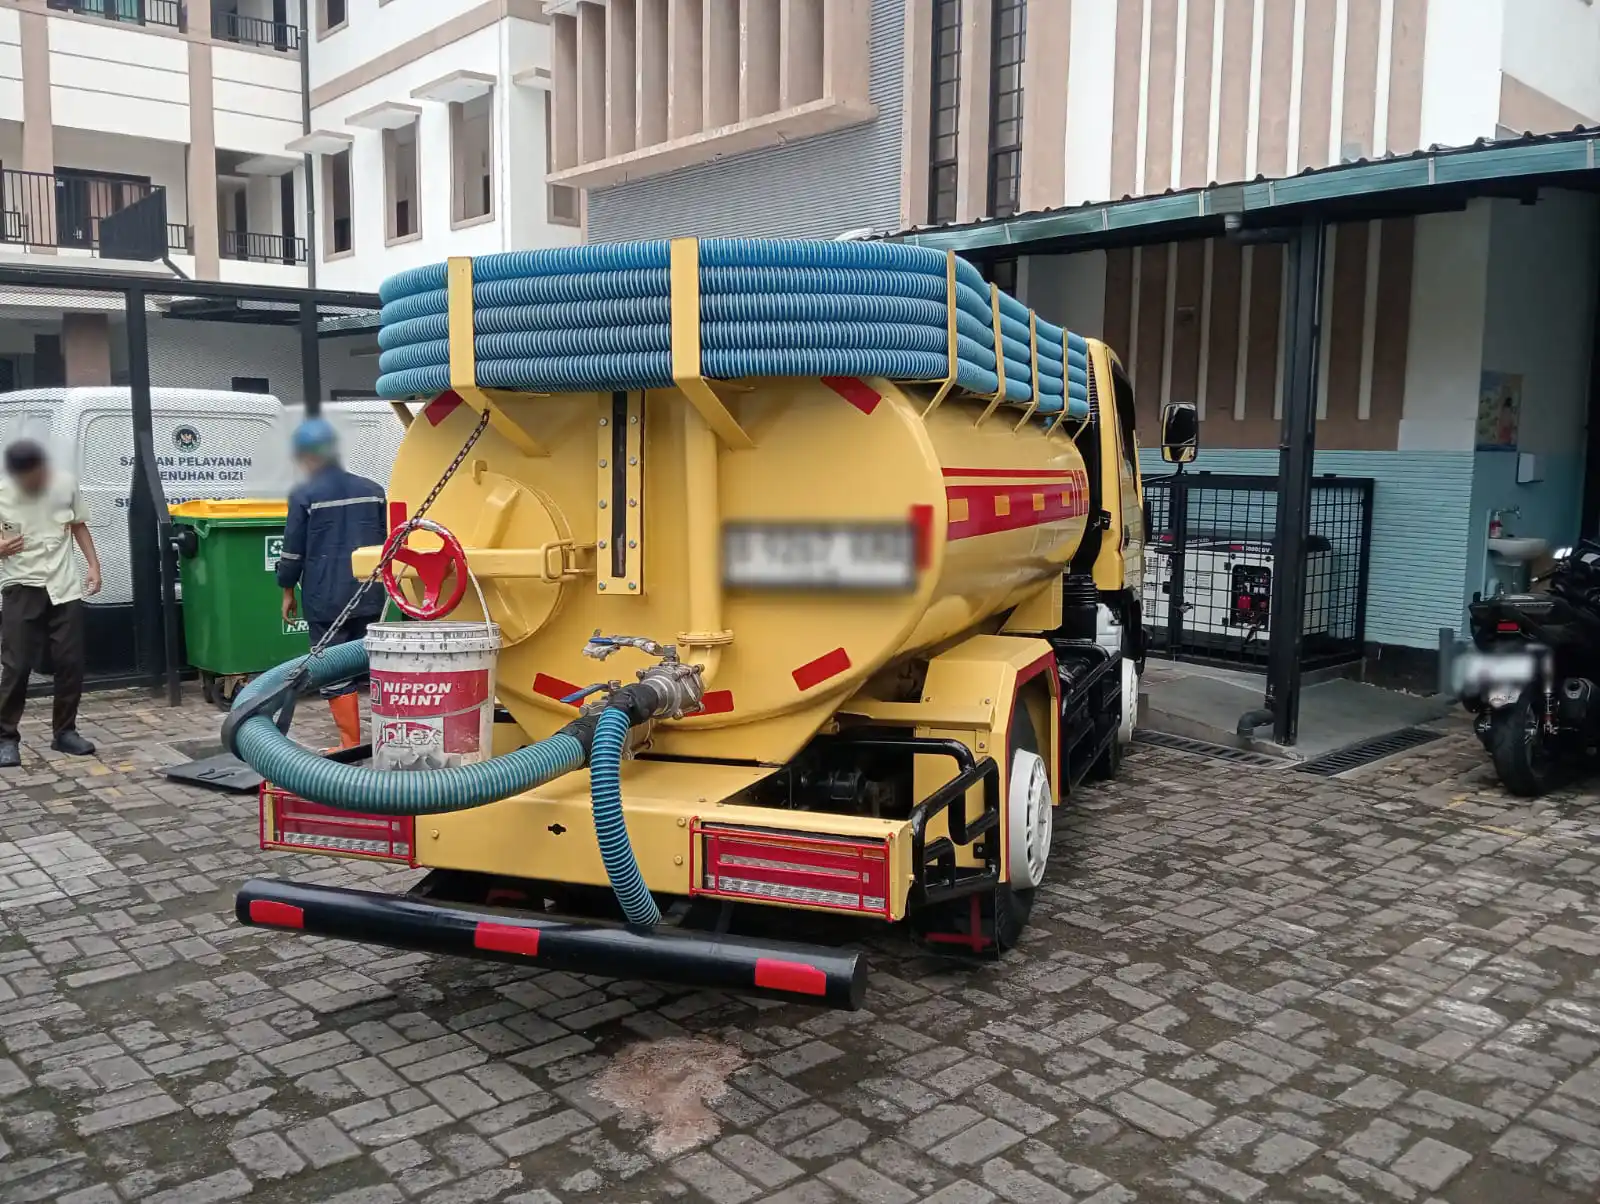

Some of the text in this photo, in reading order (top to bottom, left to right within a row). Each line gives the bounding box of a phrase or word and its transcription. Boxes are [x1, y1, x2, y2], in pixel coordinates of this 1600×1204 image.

[120, 457, 252, 467] SAAN PELAYANAN
[218, 471, 243, 480] GIZI
[383, 682, 452, 694] NIPPON
[389, 694, 444, 705] PAINT
